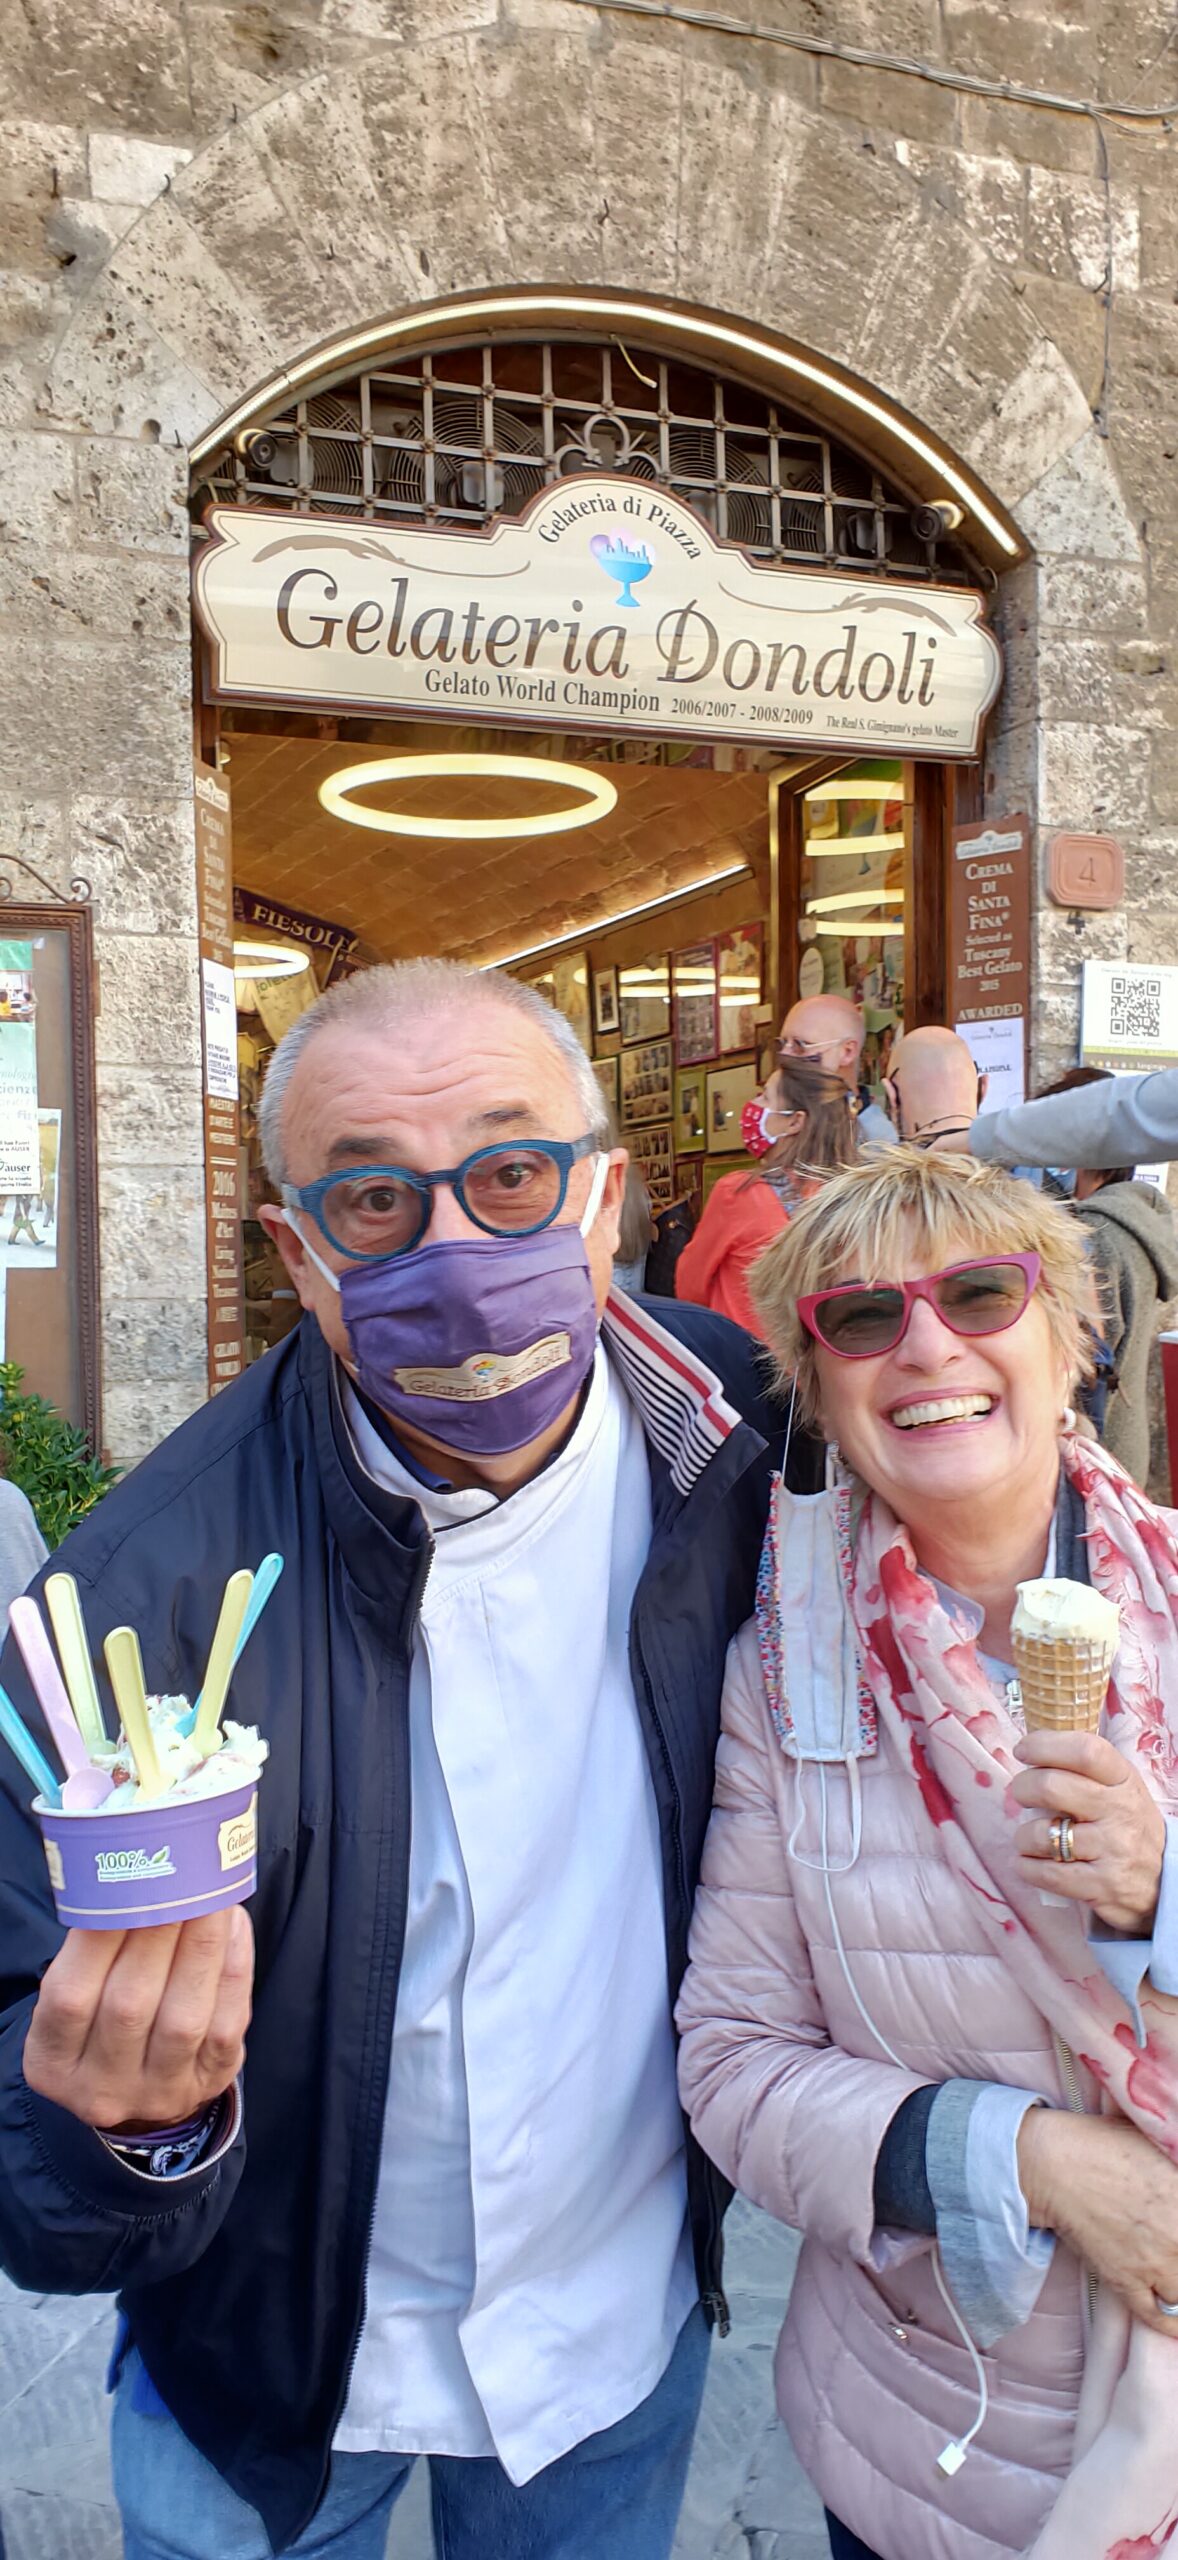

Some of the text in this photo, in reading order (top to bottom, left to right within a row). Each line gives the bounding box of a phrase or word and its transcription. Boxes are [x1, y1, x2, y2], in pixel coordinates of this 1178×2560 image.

[538, 492, 703, 561] Gelateria di Piazza
[276, 567, 937, 708] Gelateria Dondoli
[424, 668, 491, 698] Gelato
[496, 674, 557, 704] World
[562, 681, 661, 715] Champion
[670, 697, 738, 719] 2006/2007
[749, 704, 814, 726] 2008/2009
[826, 715, 840, 728] The
[840, 716, 858, 730] Real
[934, 724, 959, 738] Master
[1077, 857, 1097, 888] 4
[963, 947, 1012, 962] Tuscany
[957, 960, 1023, 979] Best Gelato
[957, 1002, 1023, 1021] AWARDED
[4, 1164, 31, 1173] auser
[212, 1170, 236, 1197] 2016
[409, 1380, 490, 1398] Gelateria
[96, 1849, 147, 1869] 100%
